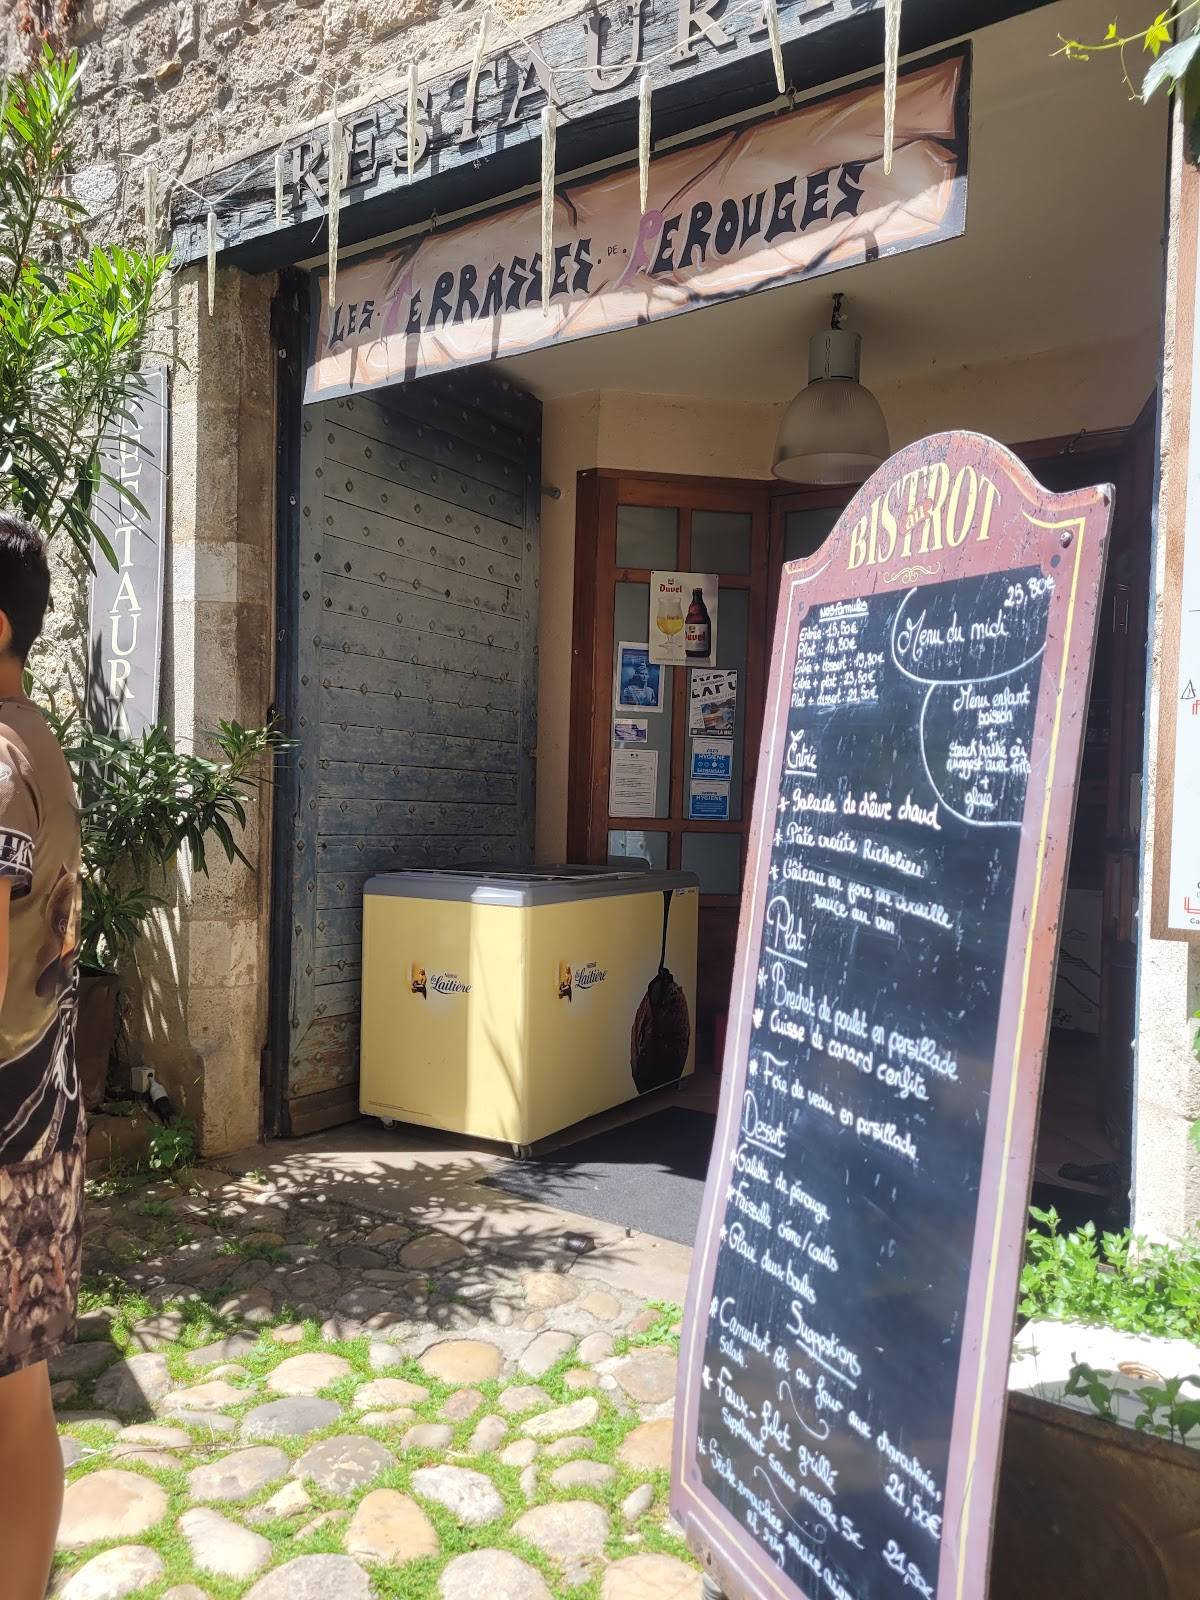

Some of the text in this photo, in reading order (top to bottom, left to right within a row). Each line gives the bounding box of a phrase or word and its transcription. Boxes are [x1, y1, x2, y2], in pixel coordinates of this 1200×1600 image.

[329, 299, 375, 346] LES
[847, 462, 1001, 571] BISTROT
[660, 584, 682, 593] Duvel
[897, 608, 1009, 663] Menu du midi
[952, 682, 1031, 711] Menu enfant
[898, 794, 942, 830] chaud
[766, 895, 806, 952] Plat
[770, 1009, 930, 1101] Cuisse de canard confite
[763, 1052, 788, 1093] Foie
[791, 1079, 806, 1099] de
[808, 1091, 835, 1115] veau
[840, 1109, 854, 1126] en
[743, 1090, 788, 1148] Dessert
